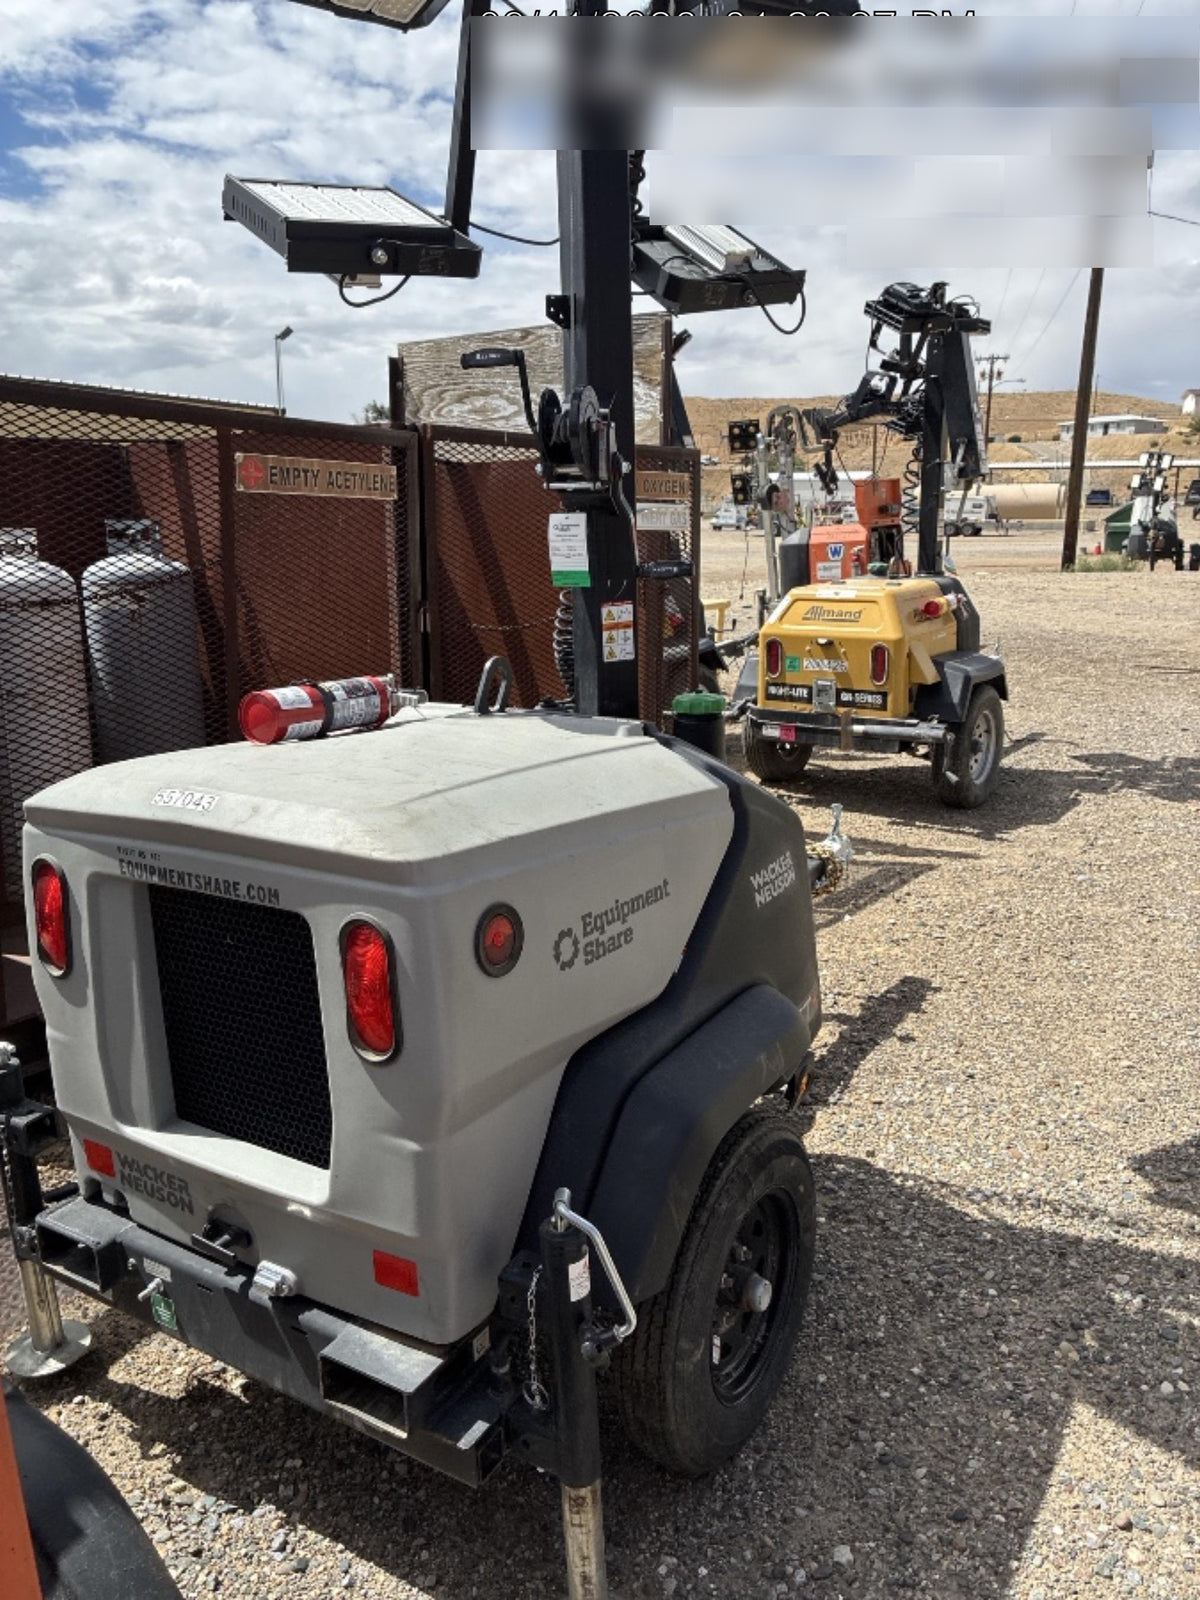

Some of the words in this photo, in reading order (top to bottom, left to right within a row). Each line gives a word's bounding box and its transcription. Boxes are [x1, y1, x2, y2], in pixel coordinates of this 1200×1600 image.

[269, 465, 320, 487] EMPTY
[326, 470, 395, 493] ACETYLENE
[643, 478, 685, 495] OXYGEN
[670, 511, 688, 526] GAS
[829, 545, 842, 558] W
[802, 605, 863, 622] Allmand
[118, 858, 280, 906] EQUIPMENTSHARE.COM
[750, 851, 795, 891] WACKER
[754, 867, 796, 909] NEUSON
[580, 878, 671, 938] Equipment
[583, 926, 634, 966] Share
[115, 1151, 191, 1197] WACKER
[120, 1170, 195, 1216] NEUSON
